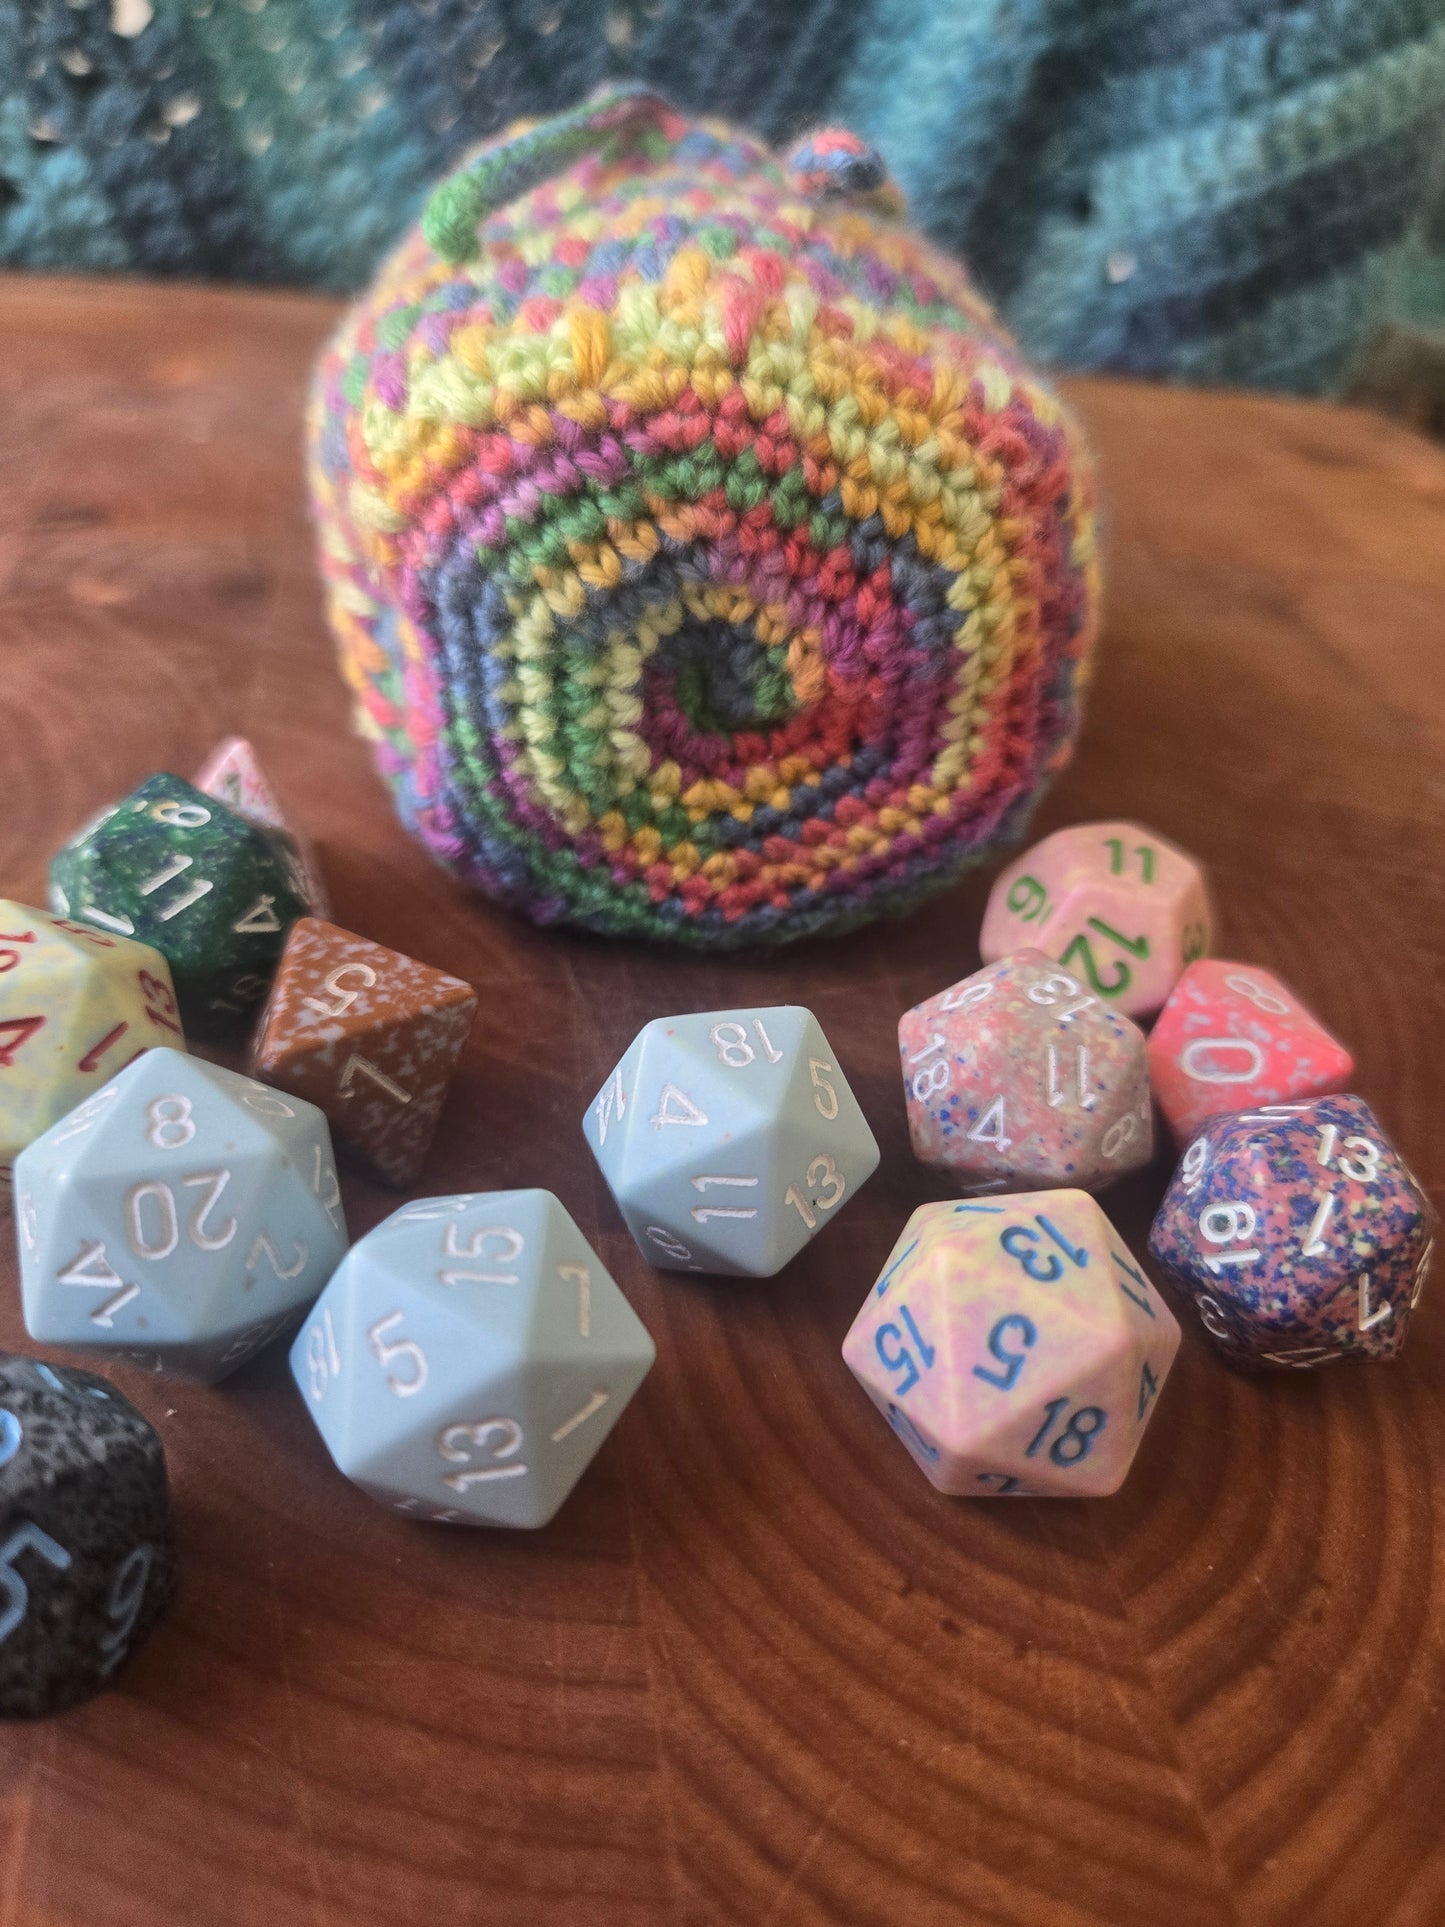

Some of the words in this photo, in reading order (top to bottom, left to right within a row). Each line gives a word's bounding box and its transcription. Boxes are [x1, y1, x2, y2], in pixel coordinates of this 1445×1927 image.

[139, 853, 214, 923] 11
[1102, 838, 1156, 886] 11
[233, 894, 281, 933] 4
[303, 962, 377, 1016] 5
[1059, 916, 1151, 998] 12
[1224, 974, 1290, 1016] 8
[709, 1018, 784, 1067] 18
[908, 1033, 950, 1103] 18
[1181, 1037, 1264, 1084] 0
[649, 1082, 709, 1131] 4
[809, 1057, 839, 1121] 5
[1047, 1044, 1097, 1108] 11
[150, 1094, 197, 1150] 8
[967, 1094, 1012, 1152] 4
[1316, 1123, 1380, 1183] 13
[126, 1169, 239, 1261] 20
[691, 1175, 759, 1223] 11
[785, 1153, 846, 1229] 13
[246, 1228, 308, 1280] 2
[438, 1222, 526, 1287] 15
[999, 1214, 1089, 1284] 13
[1199, 1200, 1261, 1275] 19
[57, 1240, 141, 1328] 14
[1111, 1251, 1157, 1320] 11
[1197, 1294, 1230, 1340] 3
[368, 1309, 429, 1399] 5
[875, 1304, 936, 1397] 15
[972, 1313, 1038, 1392] 5
[440, 1416, 528, 1493] 13
[1025, 1396, 1108, 1468] 18
